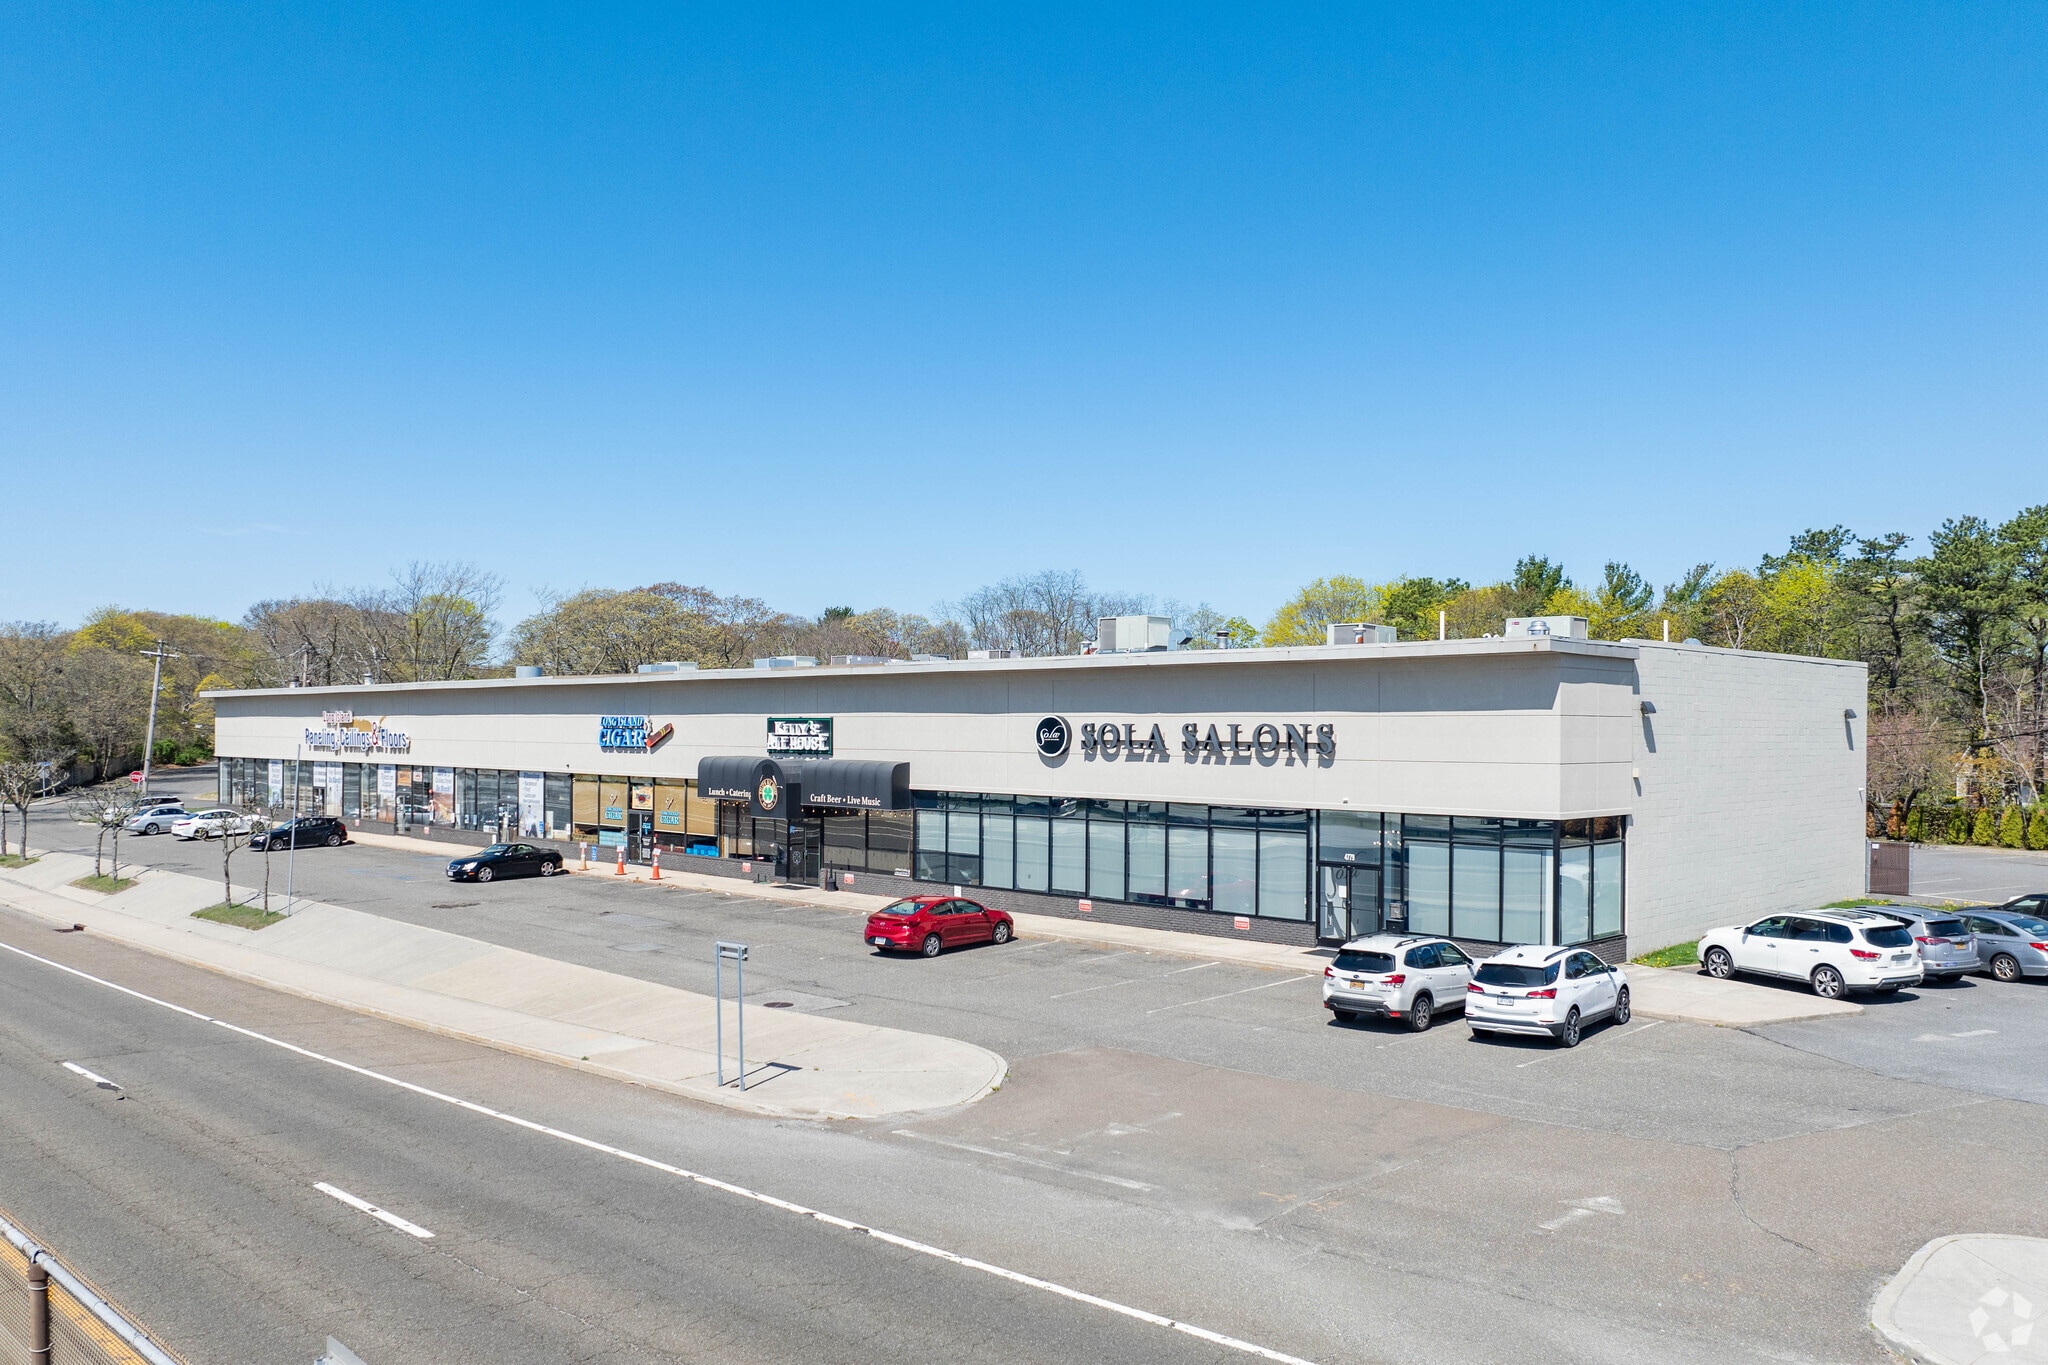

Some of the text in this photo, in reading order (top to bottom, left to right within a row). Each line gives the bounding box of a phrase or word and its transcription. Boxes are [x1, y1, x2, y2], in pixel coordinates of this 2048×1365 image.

[323, 711, 352, 724] Long Island
[600, 716, 645, 726] LONG ISLAND
[774, 721, 820, 735] KELLY'S
[305, 722, 408, 751] Paneling, Ceilings & Floors
[598, 728, 647, 748] CIGAR
[768, 733, 829, 750] ALE HOUSE
[1038, 725, 1063, 746] Sola
[1081, 723, 1335, 755] SOLA SALONS
[708, 787, 751, 800] Lunch Catering
[810, 793, 881, 806] Craft Beer Live Music
[660, 816, 680, 825] CIGAR
